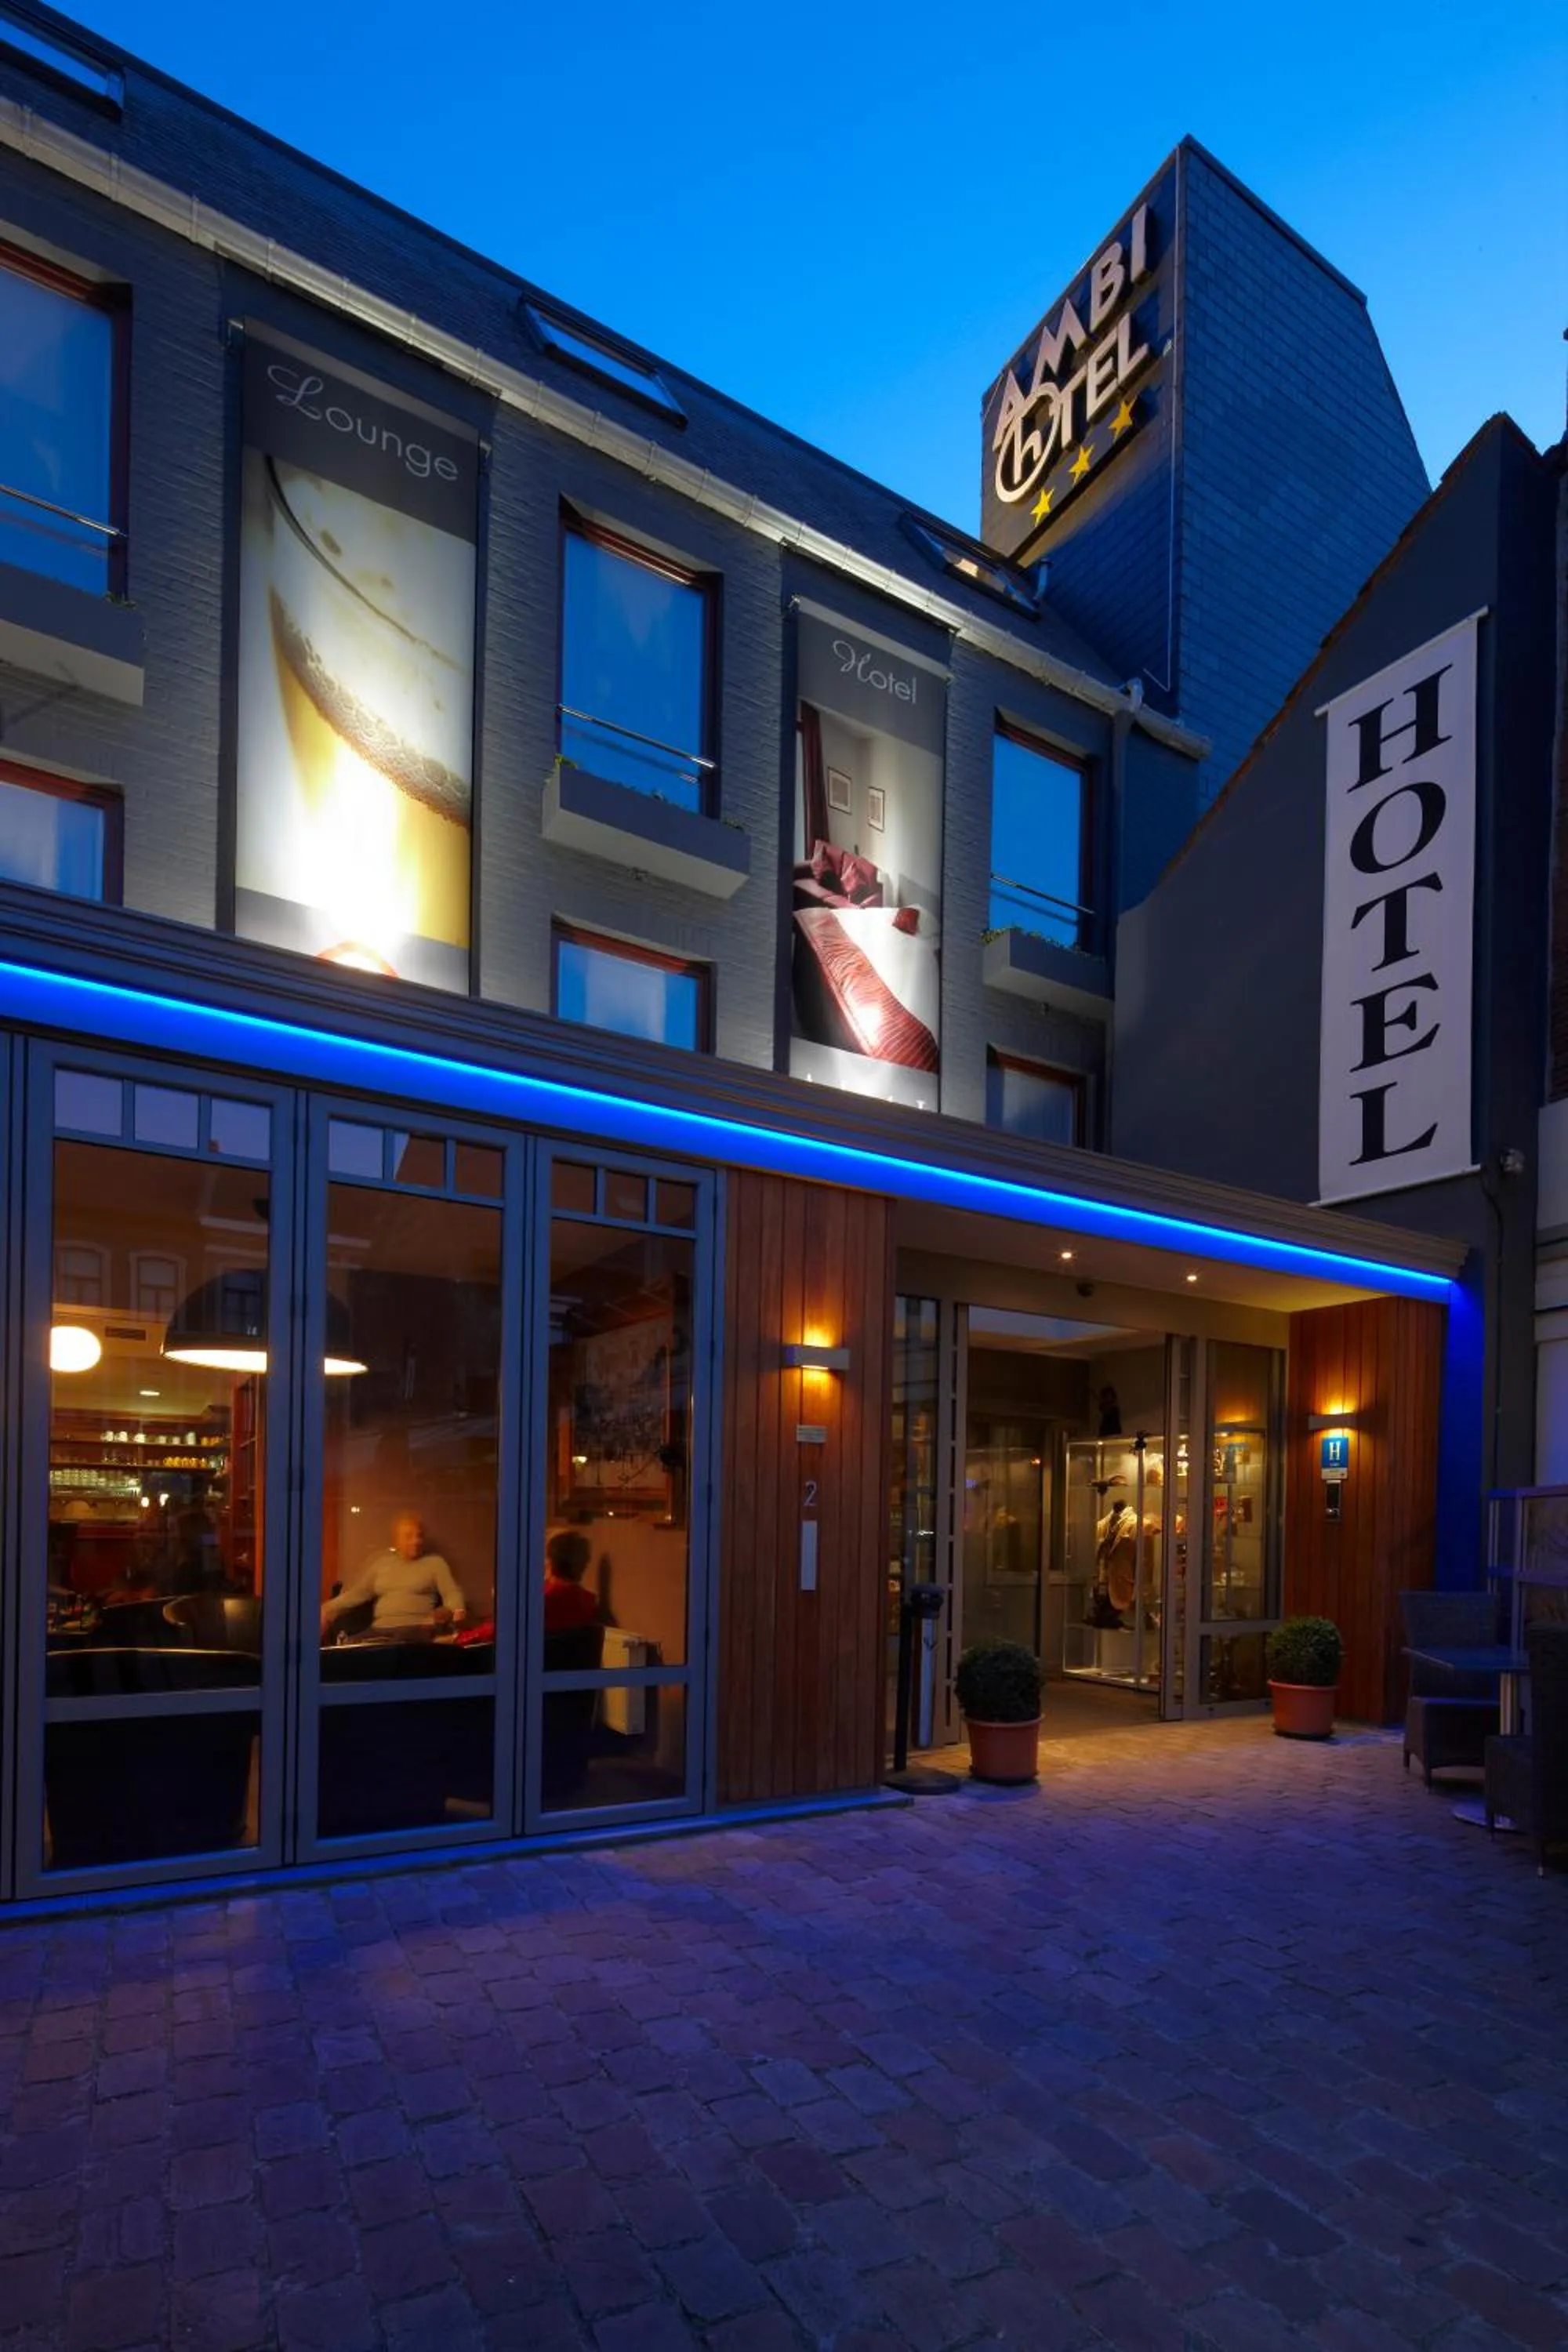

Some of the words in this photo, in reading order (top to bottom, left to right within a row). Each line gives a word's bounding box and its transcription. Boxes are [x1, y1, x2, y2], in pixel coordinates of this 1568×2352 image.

[992, 201, 1149, 452] AMBI
[267, 365, 459, 481] Lounge
[832, 640, 917, 704] Hotel
[1347, 663, 1454, 1167] HOTEL
[804, 1480, 817, 1507] 2
[1329, 1441, 1341, 1461] H
